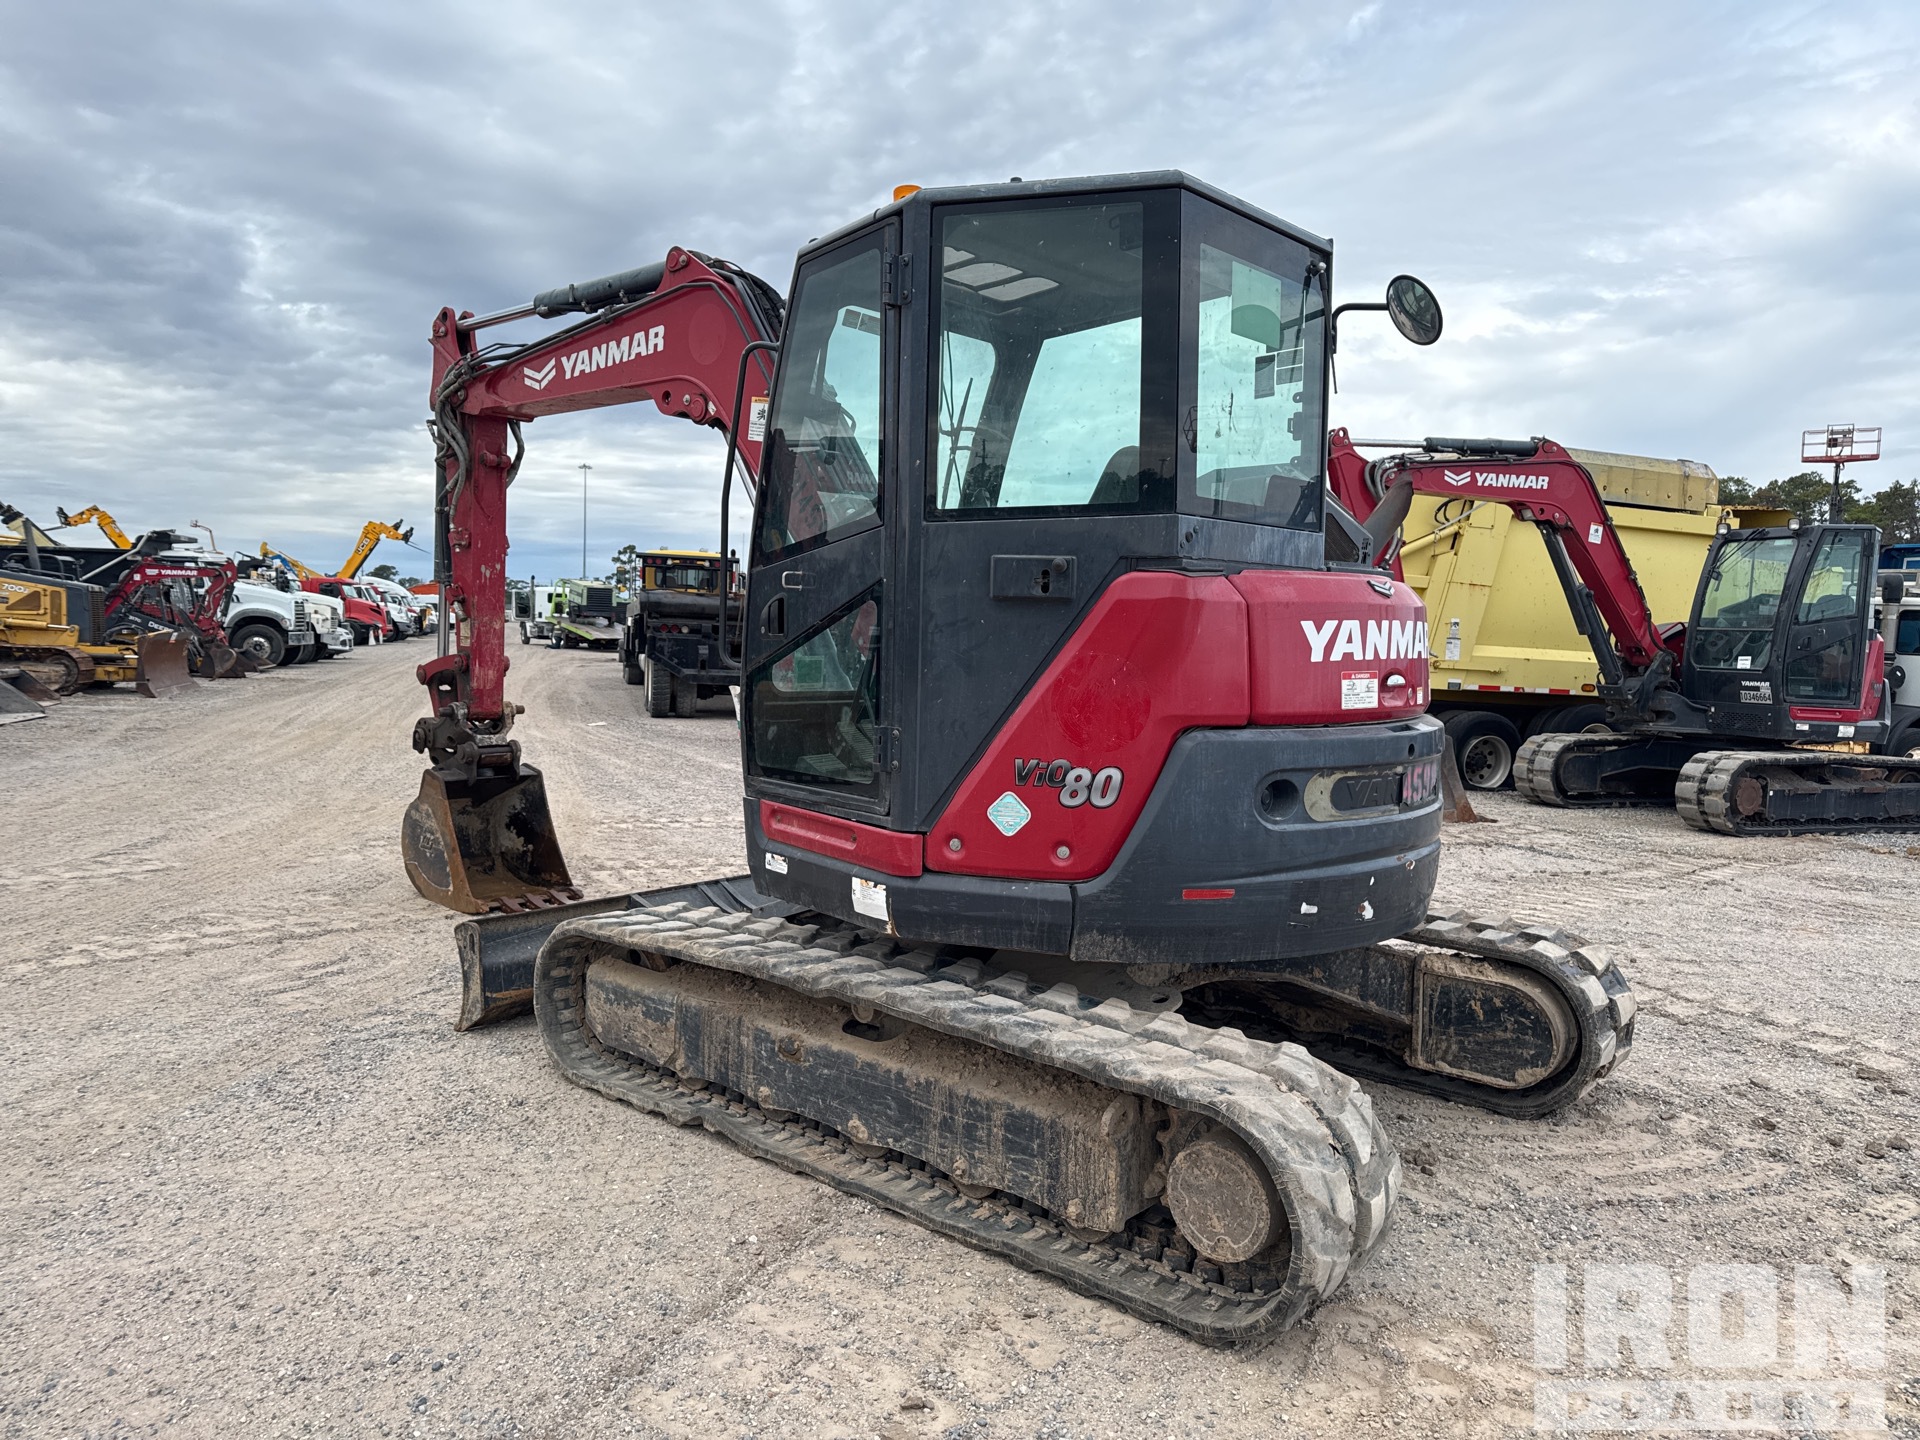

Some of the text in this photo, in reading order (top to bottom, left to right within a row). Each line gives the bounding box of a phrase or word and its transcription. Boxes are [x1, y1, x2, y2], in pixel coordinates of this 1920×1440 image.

[560, 324, 665, 380] YANMAR
[1474, 471, 1549, 490] YANMAR
[1741, 680, 1770, 688] YANMAR
